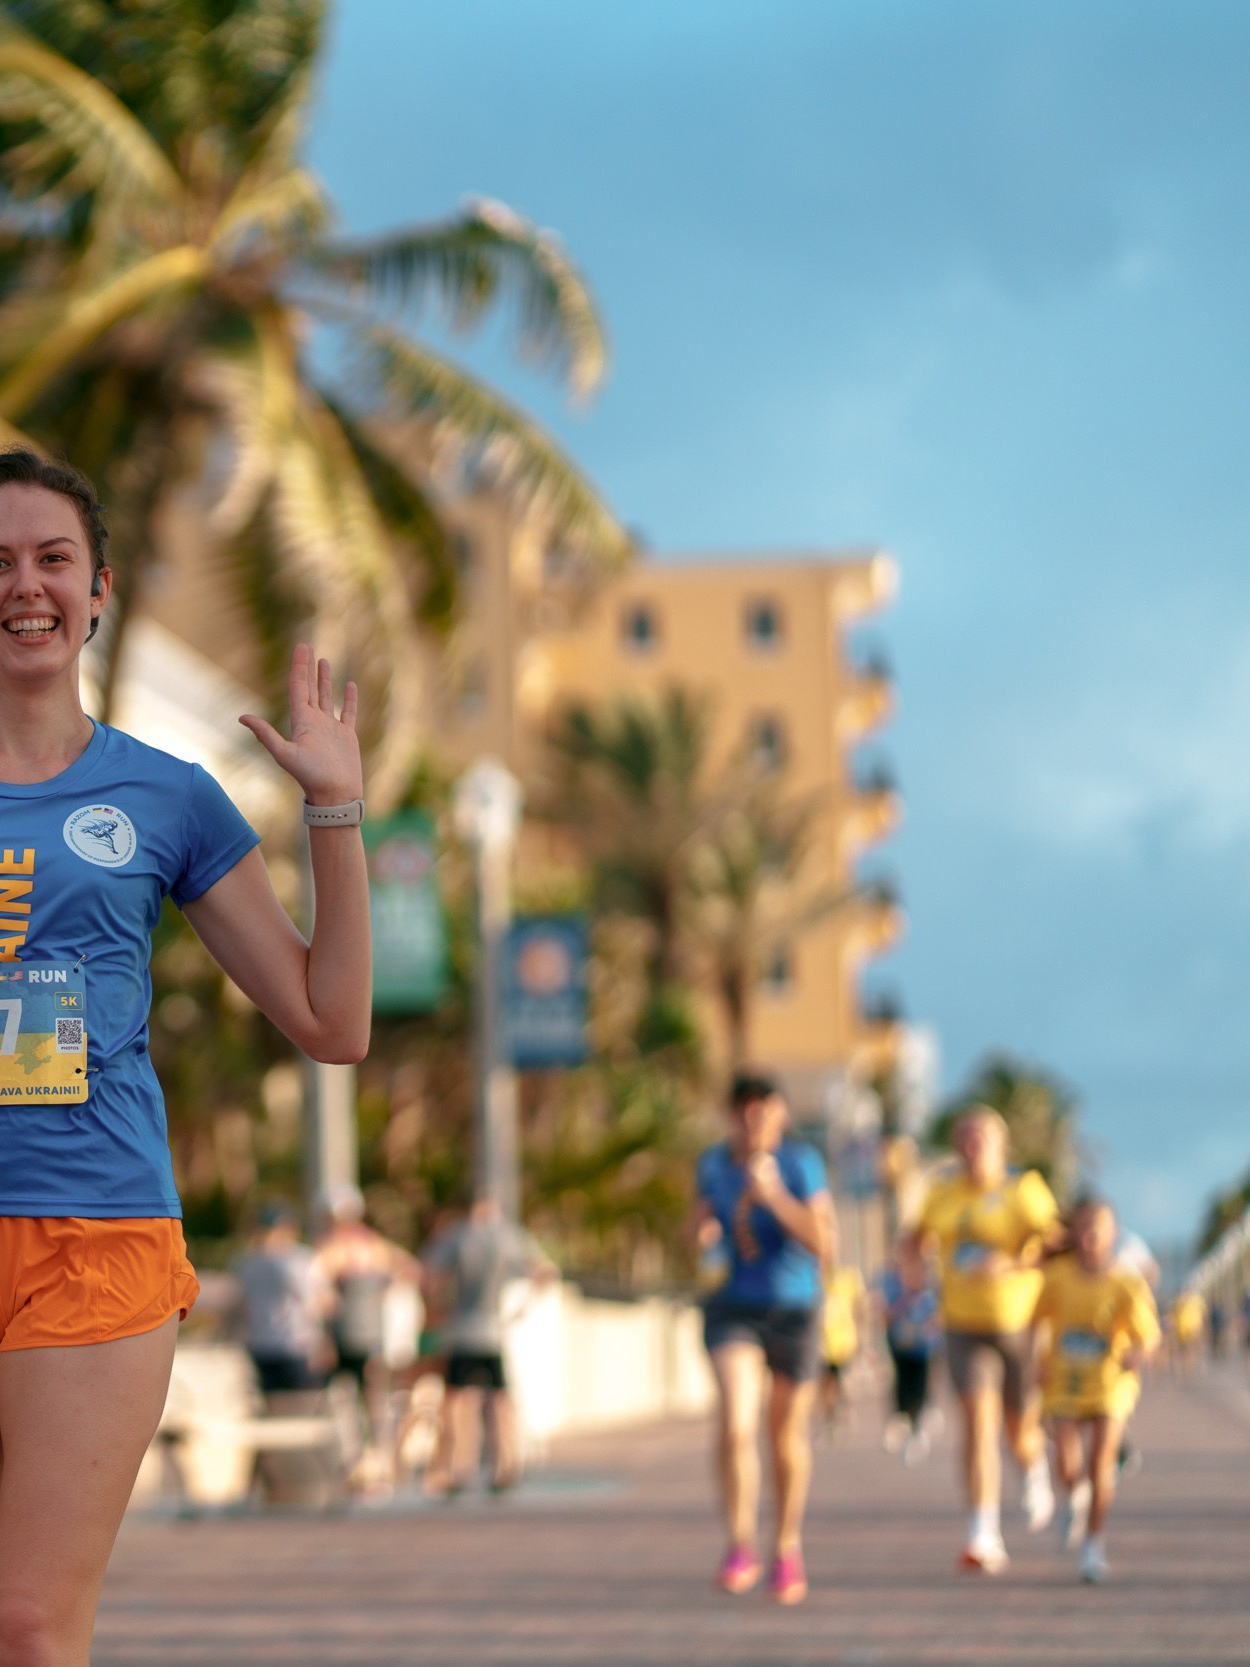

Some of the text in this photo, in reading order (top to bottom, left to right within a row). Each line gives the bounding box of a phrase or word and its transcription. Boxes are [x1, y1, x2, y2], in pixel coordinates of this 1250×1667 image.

[70, 809, 129, 826] RAZOM RUN
[28, 970, 67, 983] RUN
[60, 996, 78, 1007] 5K
[25, 1085, 81, 1096] UKRAINI!
